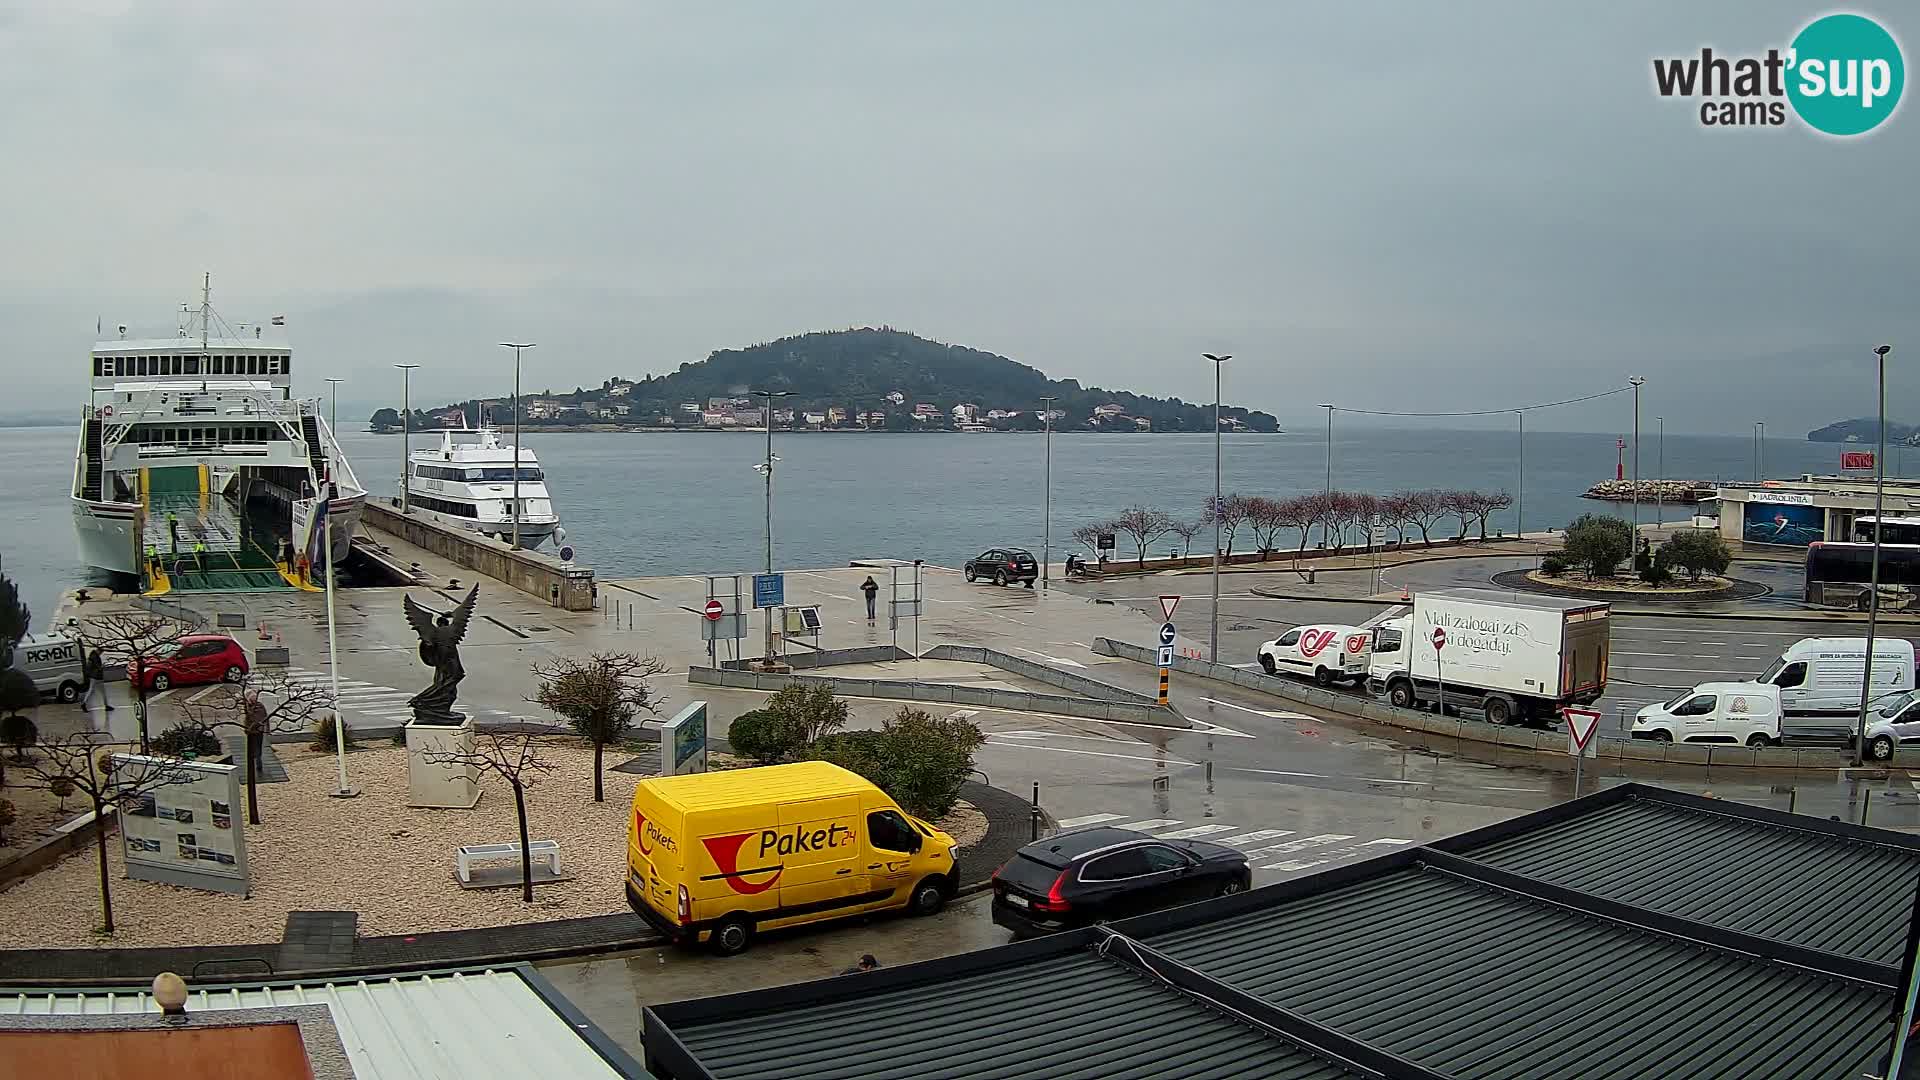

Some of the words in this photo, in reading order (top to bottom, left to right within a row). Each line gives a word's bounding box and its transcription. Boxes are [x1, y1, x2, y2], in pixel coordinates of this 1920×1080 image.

[1424, 609, 1451, 627] Mali
[1453, 615, 1500, 636] zalogaj
[26, 645, 74, 664] PIGMENT
